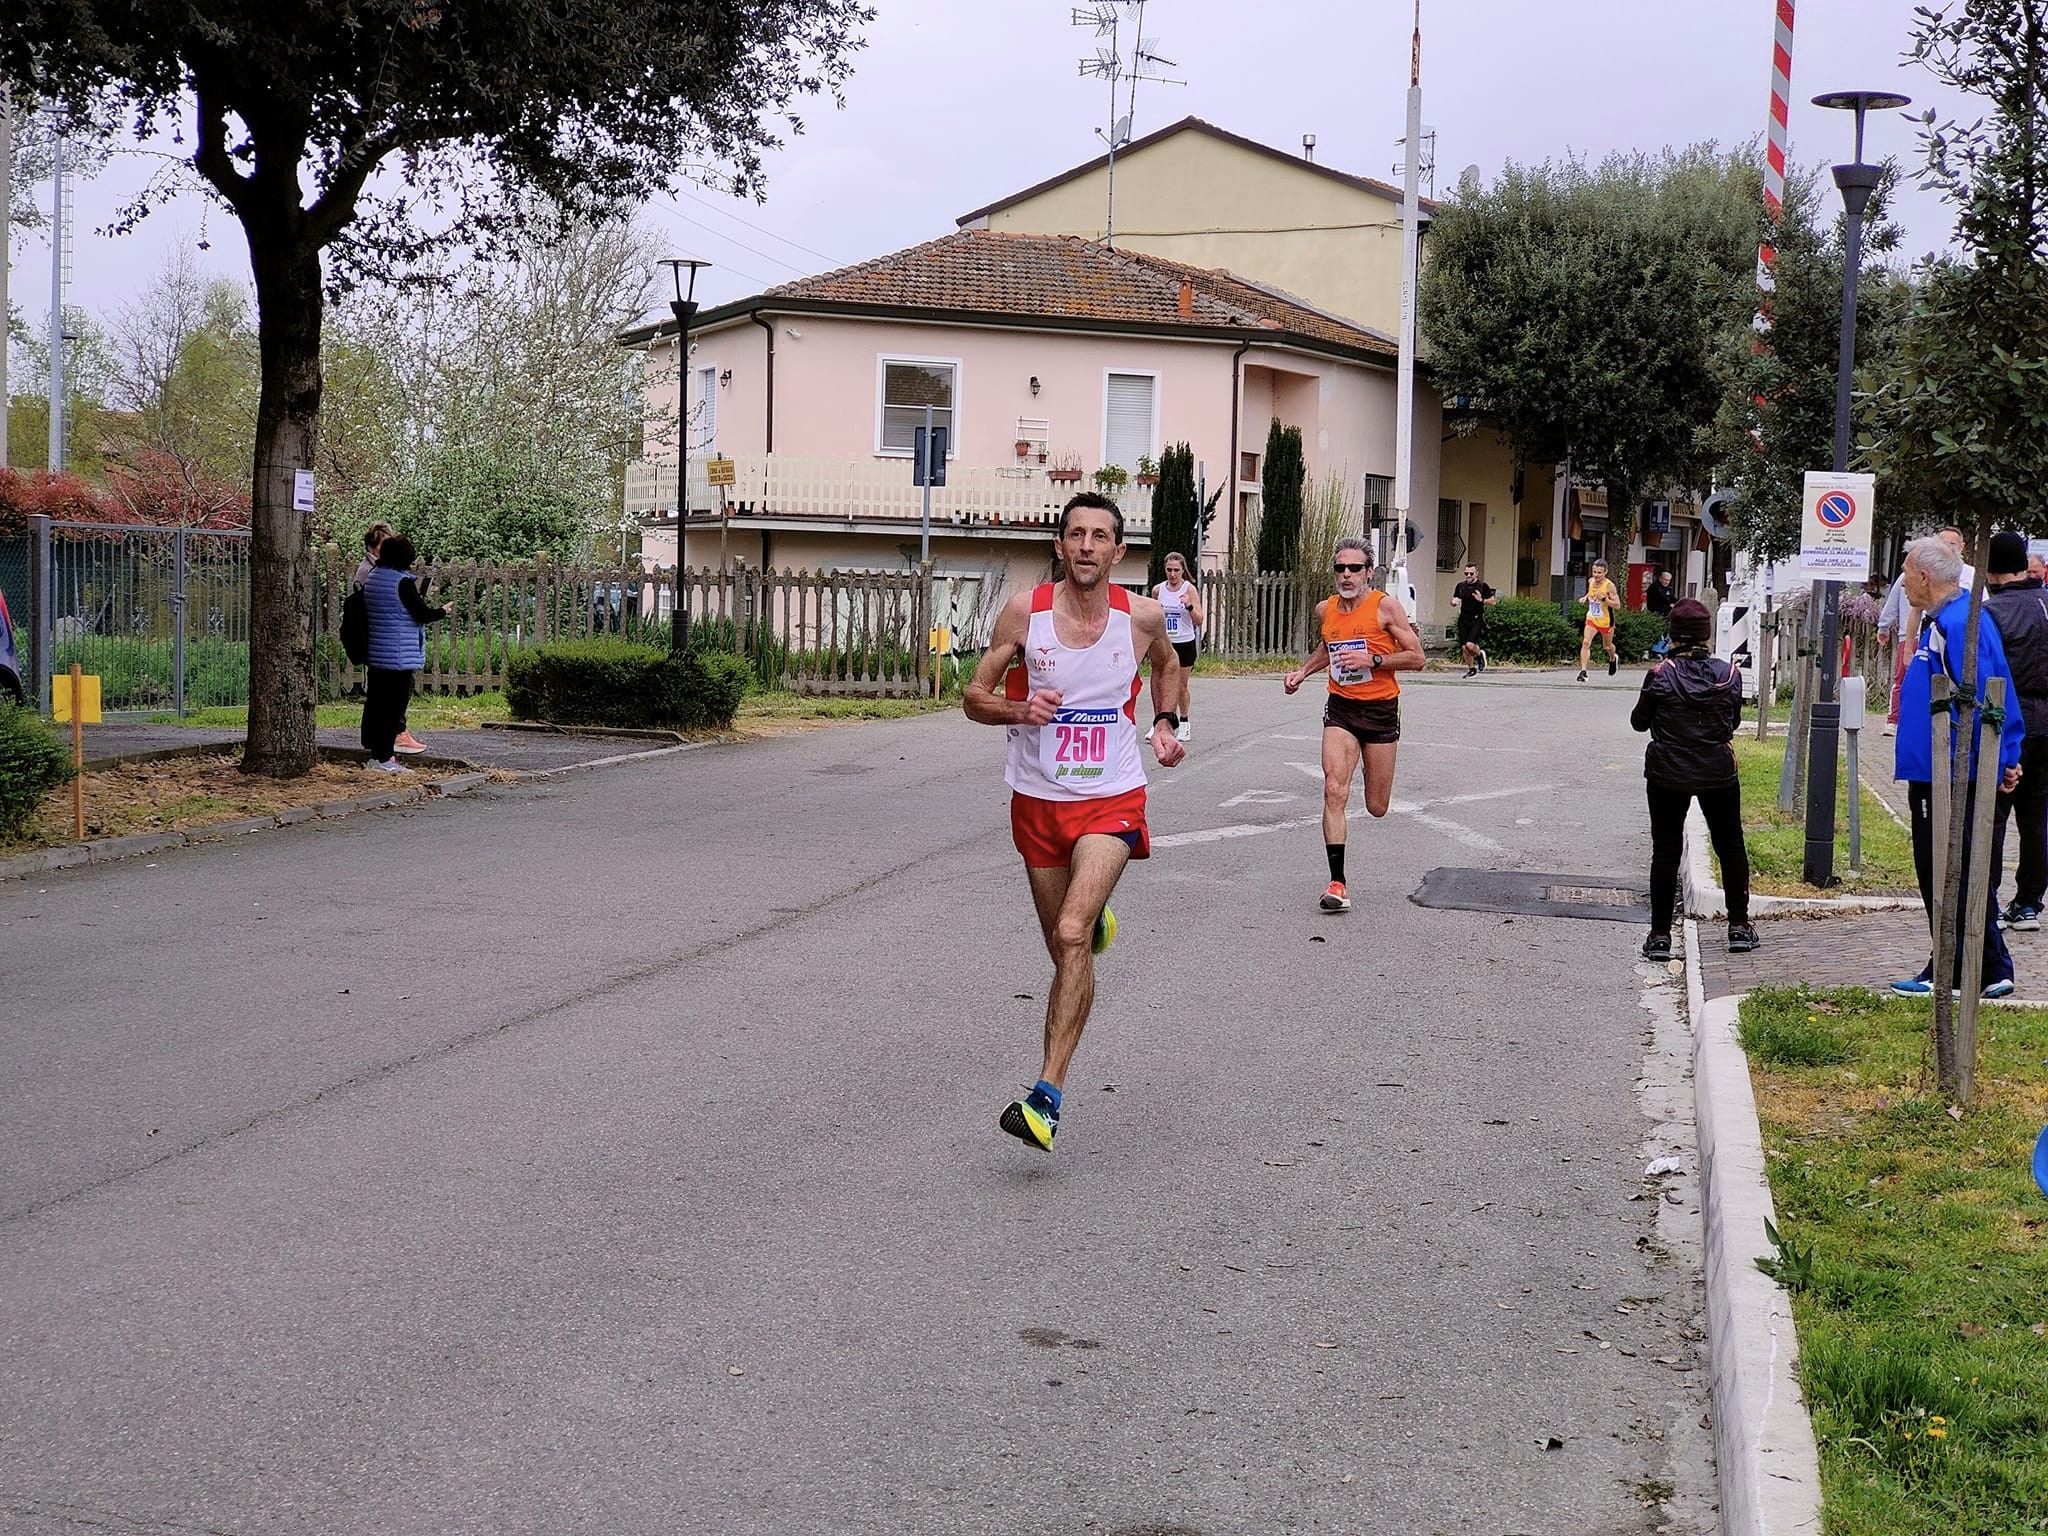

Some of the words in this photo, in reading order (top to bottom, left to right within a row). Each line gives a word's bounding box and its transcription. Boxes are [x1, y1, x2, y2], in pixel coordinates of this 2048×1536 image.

[1585, 492, 1605, 504] TABAC
[1653, 501, 1668, 523] T
[1167, 618, 1177, 630] 06
[1055, 726, 1106, 762] 250
